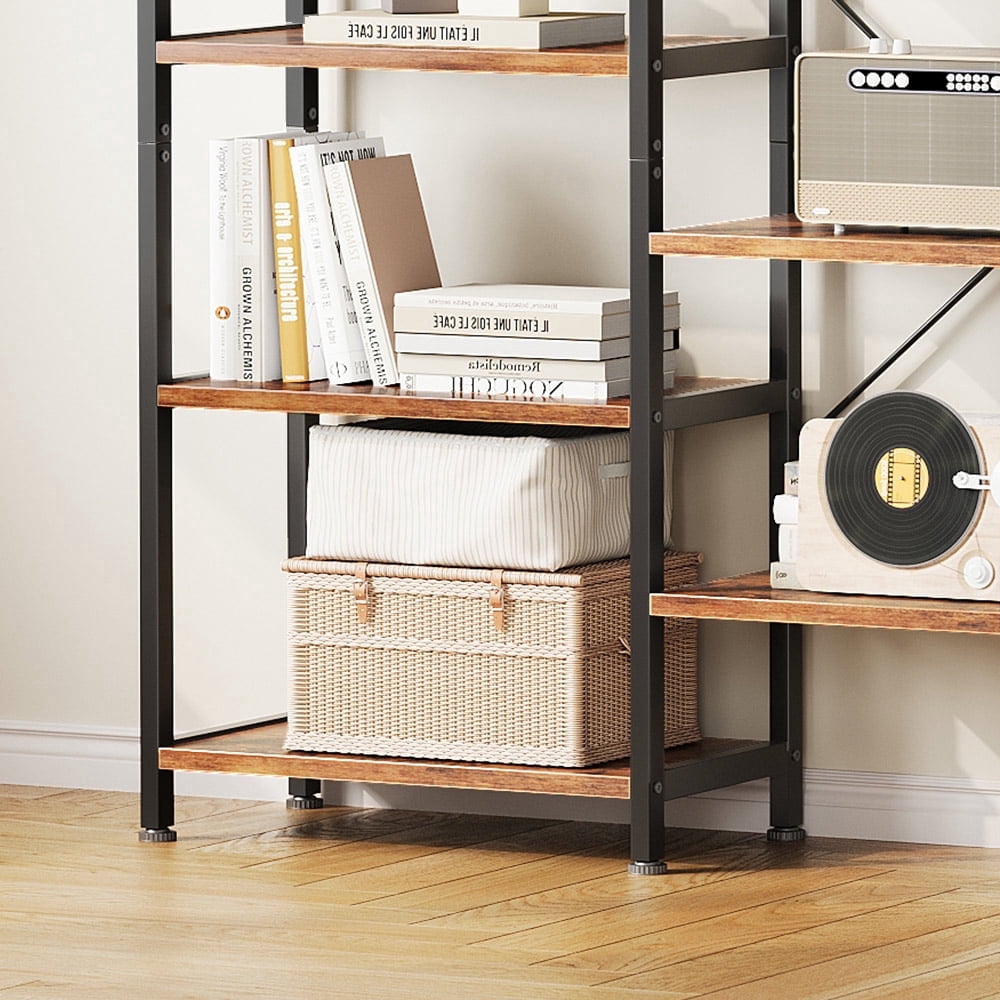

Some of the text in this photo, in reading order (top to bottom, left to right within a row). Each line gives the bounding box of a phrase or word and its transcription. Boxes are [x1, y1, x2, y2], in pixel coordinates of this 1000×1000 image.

[274, 202, 294, 227] arts
[242, 267, 254, 381] GROWN ALCHEMIS
[276, 246, 299, 322] architecture
[356, 280, 388, 385] GROWN ALCHEMIS
